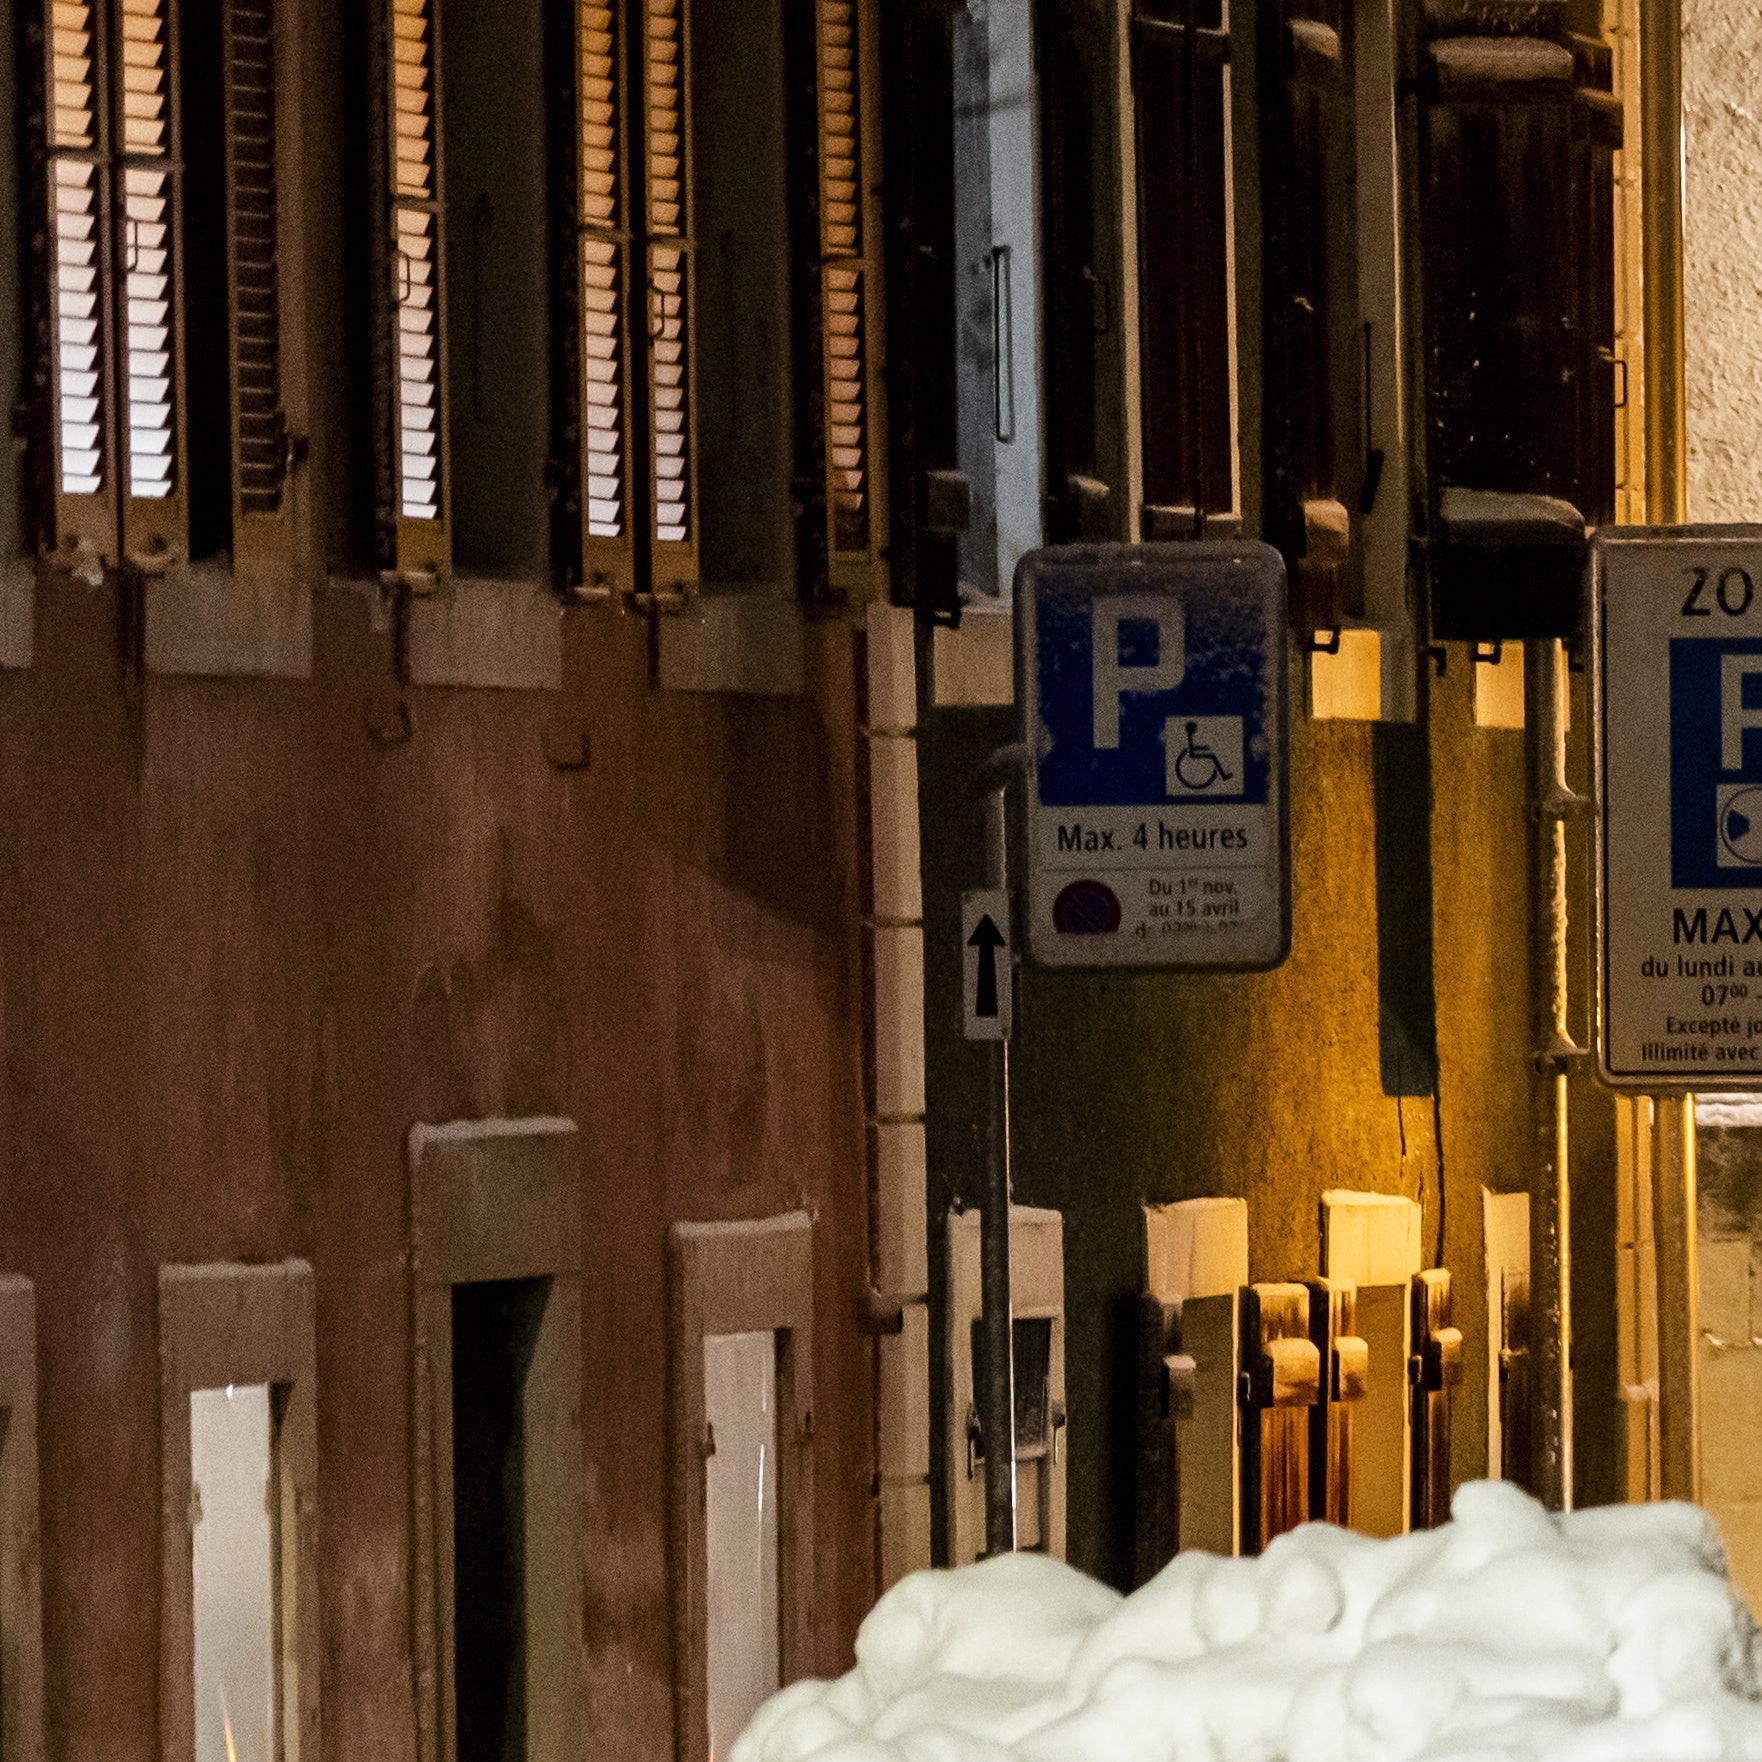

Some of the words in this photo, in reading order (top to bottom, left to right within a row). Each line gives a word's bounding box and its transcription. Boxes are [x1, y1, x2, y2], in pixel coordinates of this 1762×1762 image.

[1092, 596, 1186, 749] P
[1057, 823, 1123, 851] Max.
[1132, 822, 1148, 850] 4
[1159, 820, 1248, 850] heures
[1148, 878, 1172, 896] Du
[1148, 904, 1169, 917] au
[1176, 899, 1197, 917] 15
[1202, 899, 1240, 917] avril
[1640, 955, 1668, 977] du
[1677, 954, 1734, 977] lundi
[1666, 1015, 1741, 1038] Excepté
[1641, 1042, 1709, 1062] Illimité
[1714, 1046, 1759, 1061] avec
